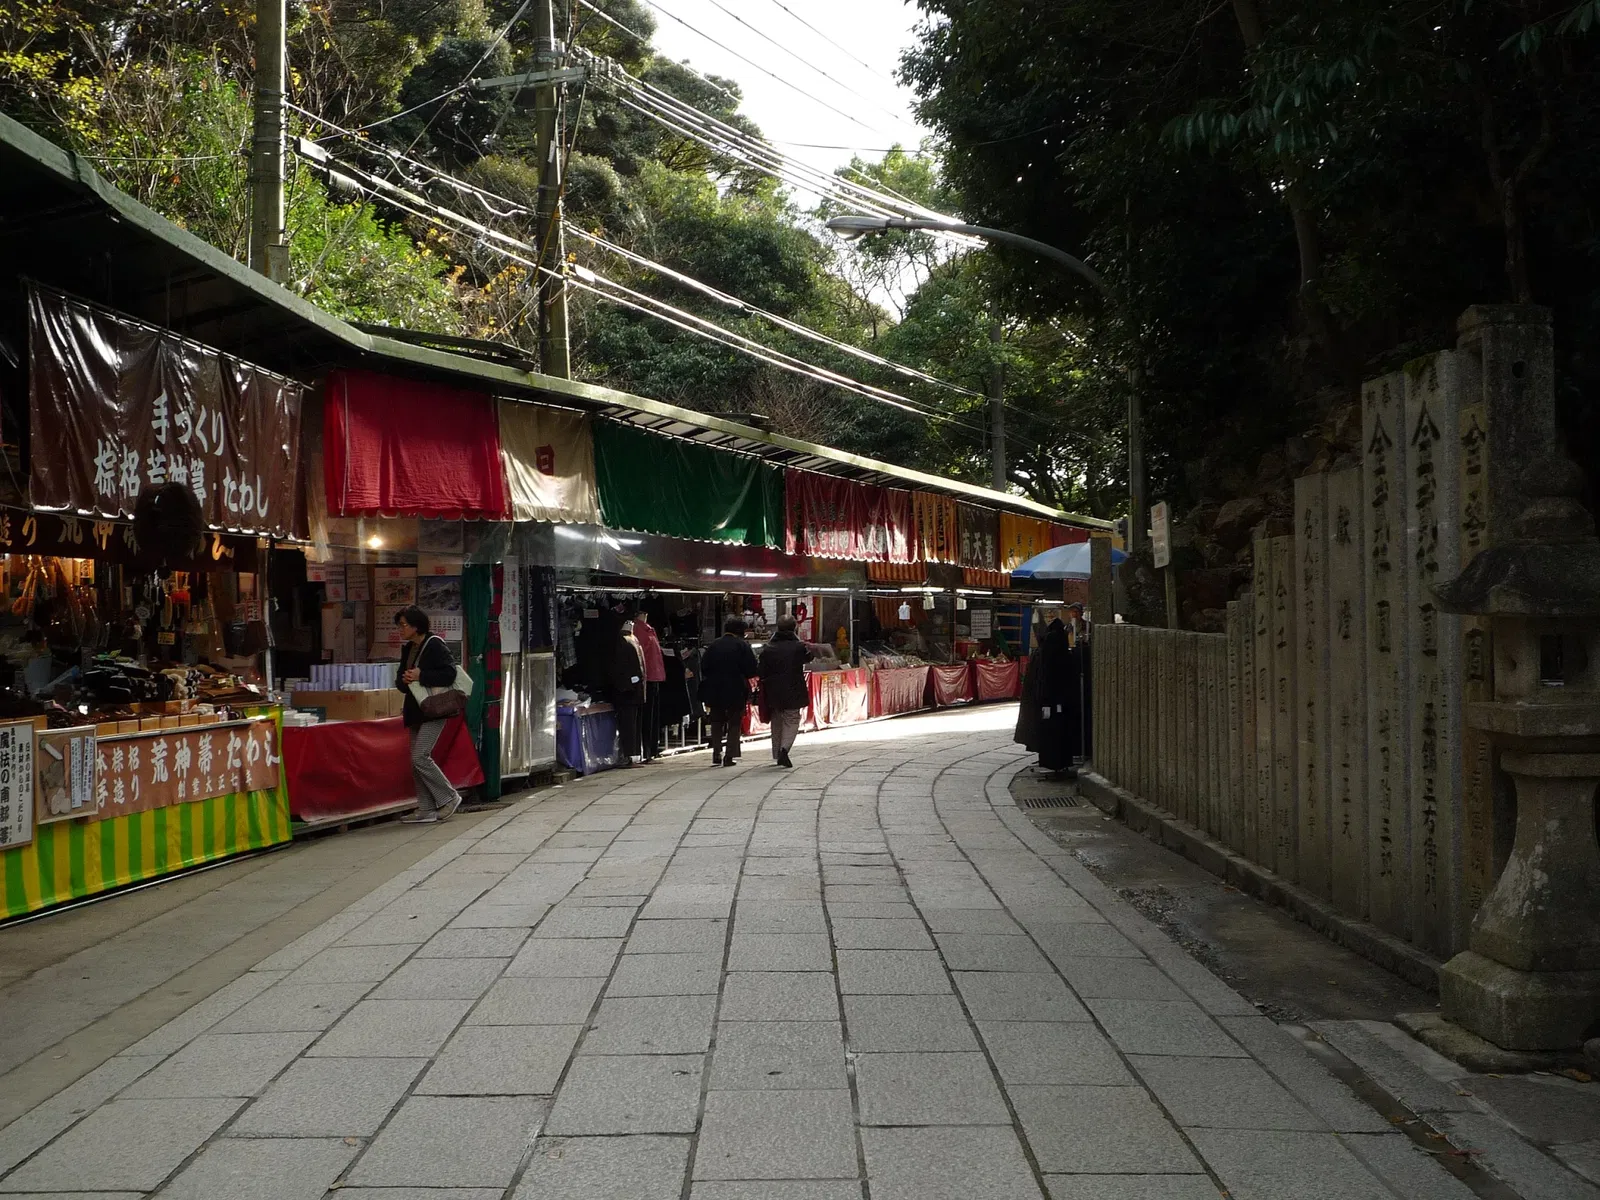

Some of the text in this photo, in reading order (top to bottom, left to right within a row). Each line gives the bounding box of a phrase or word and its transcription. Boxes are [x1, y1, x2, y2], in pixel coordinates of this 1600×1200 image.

[151, 388, 225, 456] 手づくり
[97, 774, 140, 808] 手造り
[178, 768, 253, 799] 創業大正七年
